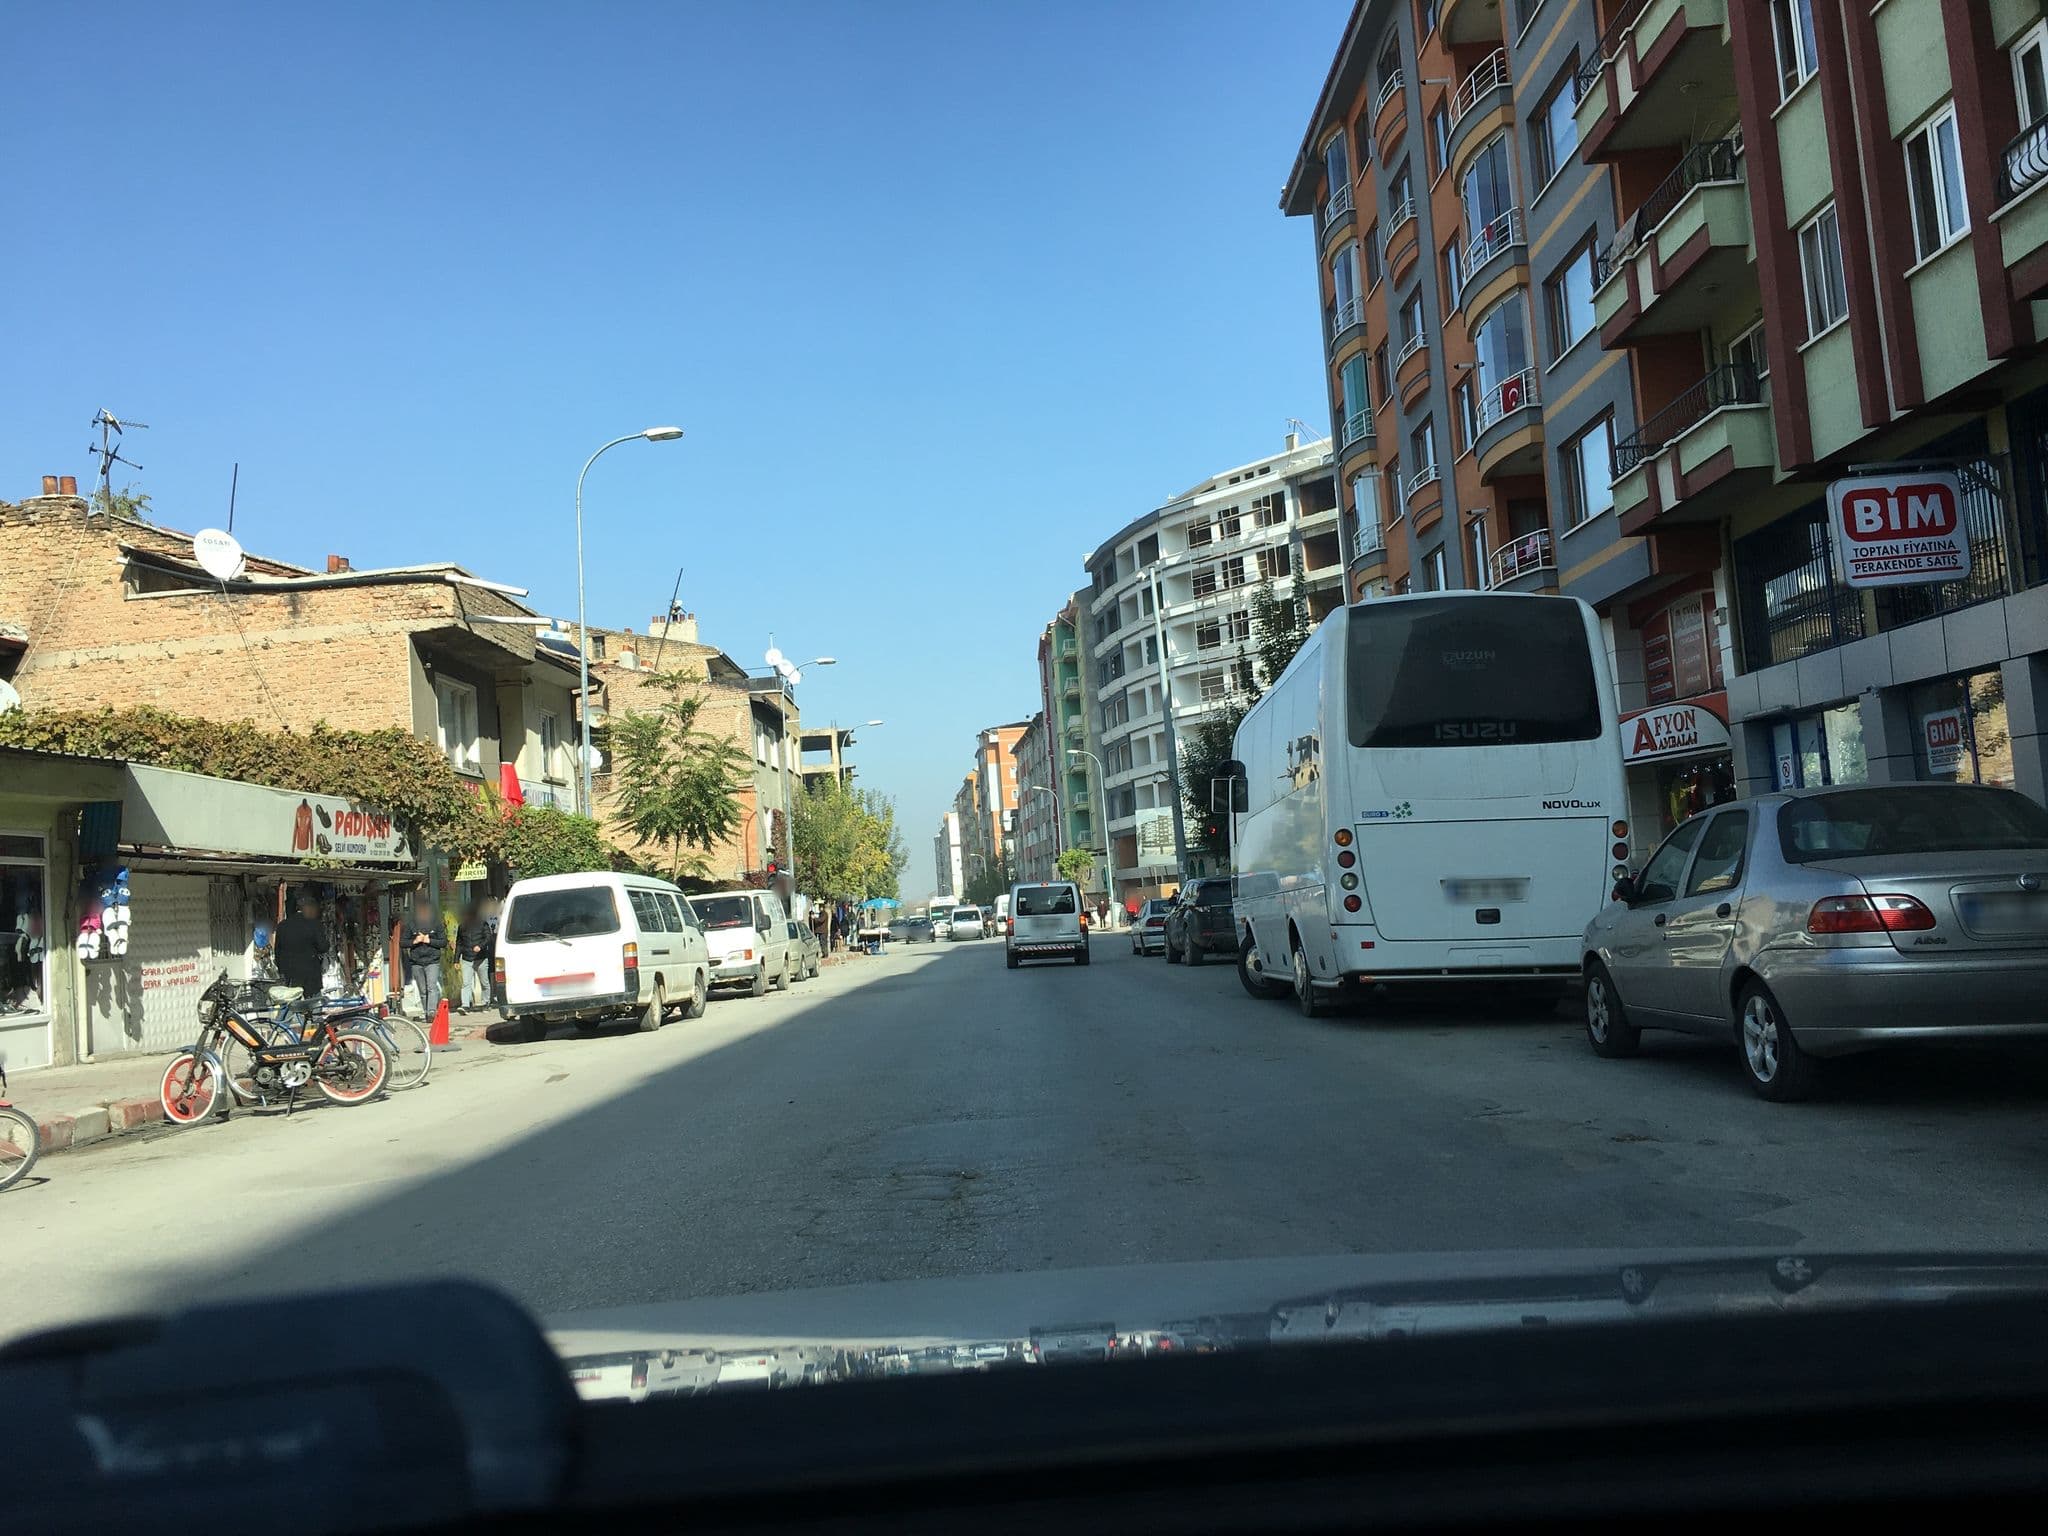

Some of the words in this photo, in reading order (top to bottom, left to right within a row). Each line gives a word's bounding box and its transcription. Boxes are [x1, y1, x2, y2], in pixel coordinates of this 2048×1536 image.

[1853, 545, 1899, 558] TOPTAN
[1903, 540, 1957, 554] FİYATINA
[1854, 559, 1923, 573] PERAKENDE
[1927, 555, 1959, 568] SATIŞ
[1434, 722, 1517, 738] ISUZU
[1632, 709, 1697, 755] AFYON
[1658, 731, 1699, 751] AMBALAJ
